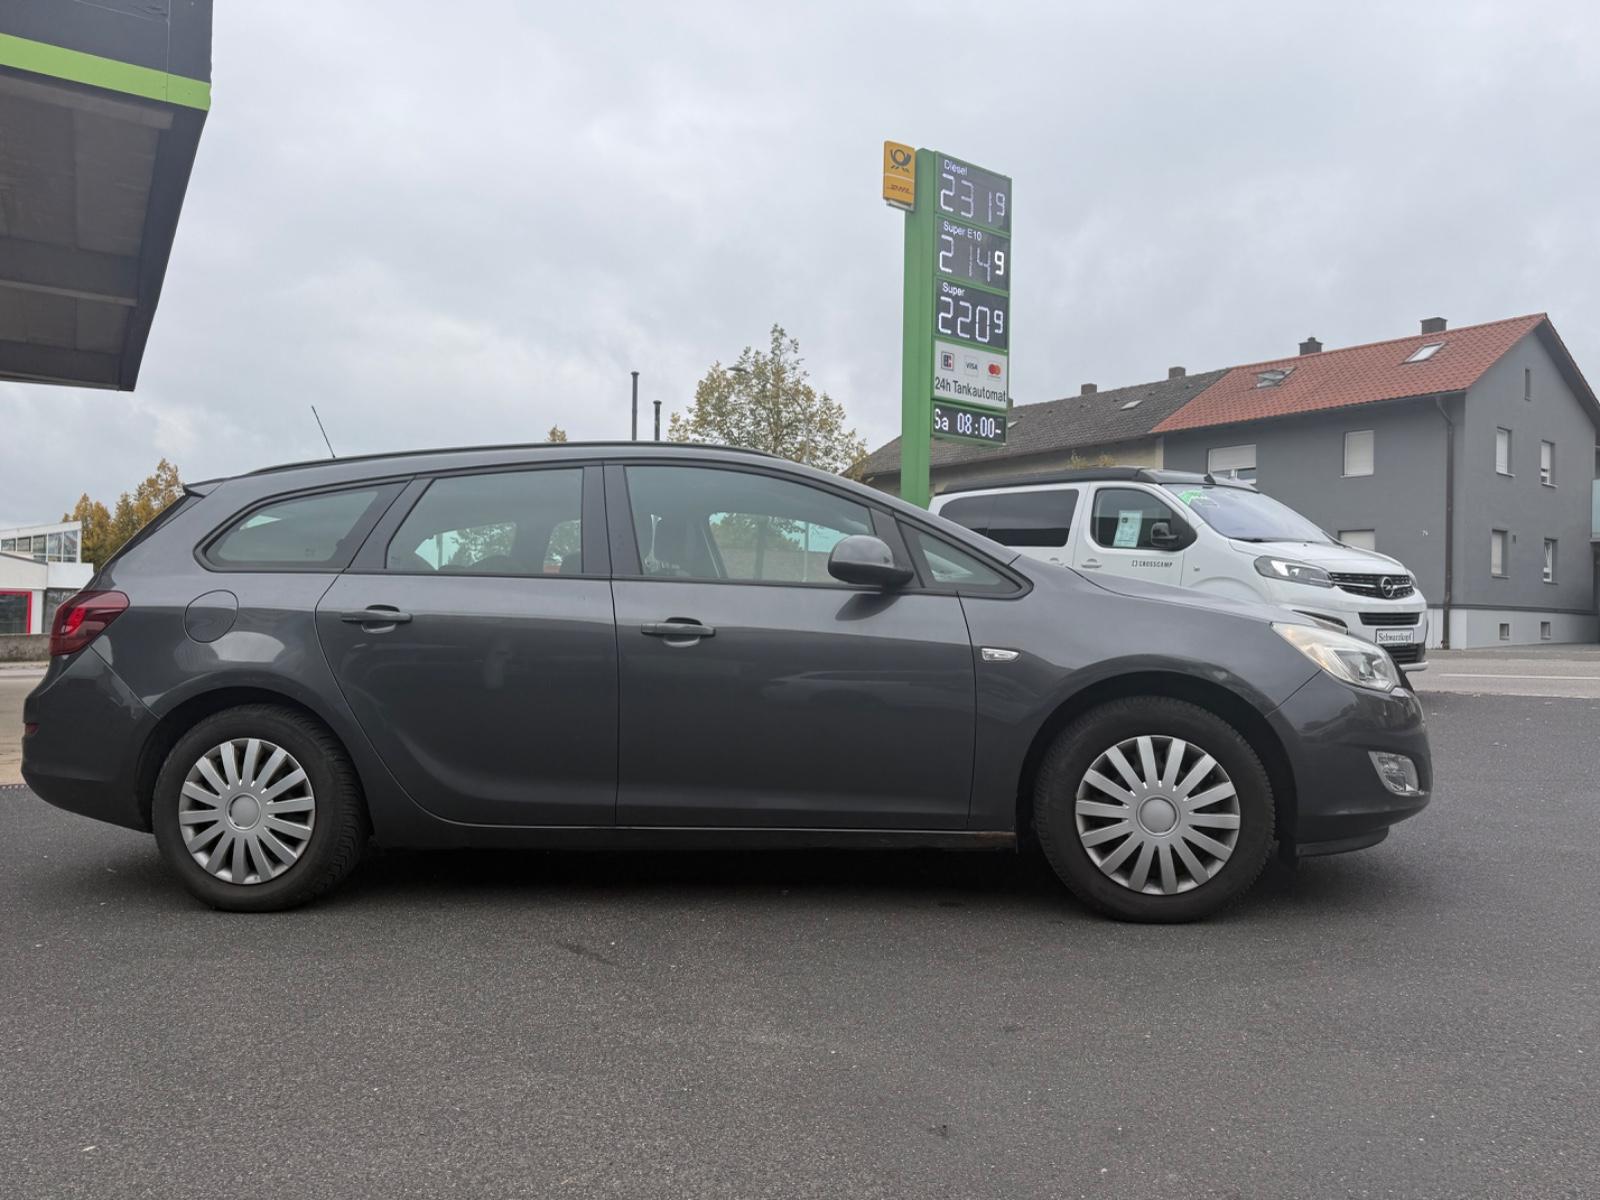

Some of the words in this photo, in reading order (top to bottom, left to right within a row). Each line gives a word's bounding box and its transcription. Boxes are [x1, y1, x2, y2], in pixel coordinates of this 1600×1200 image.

[944, 159, 968, 176] Diesel
[943, 221, 966, 236] Super
[967, 229, 983, 241] E10
[942, 282, 966, 297] Super
[966, 361, 978, 370] VISA
[935, 376, 951, 393] 24h
[953, 380, 1007, 402] Tankautomat
[934, 408, 949, 431] Sa
[1139, 560, 1173, 568] CROSSCAMP
